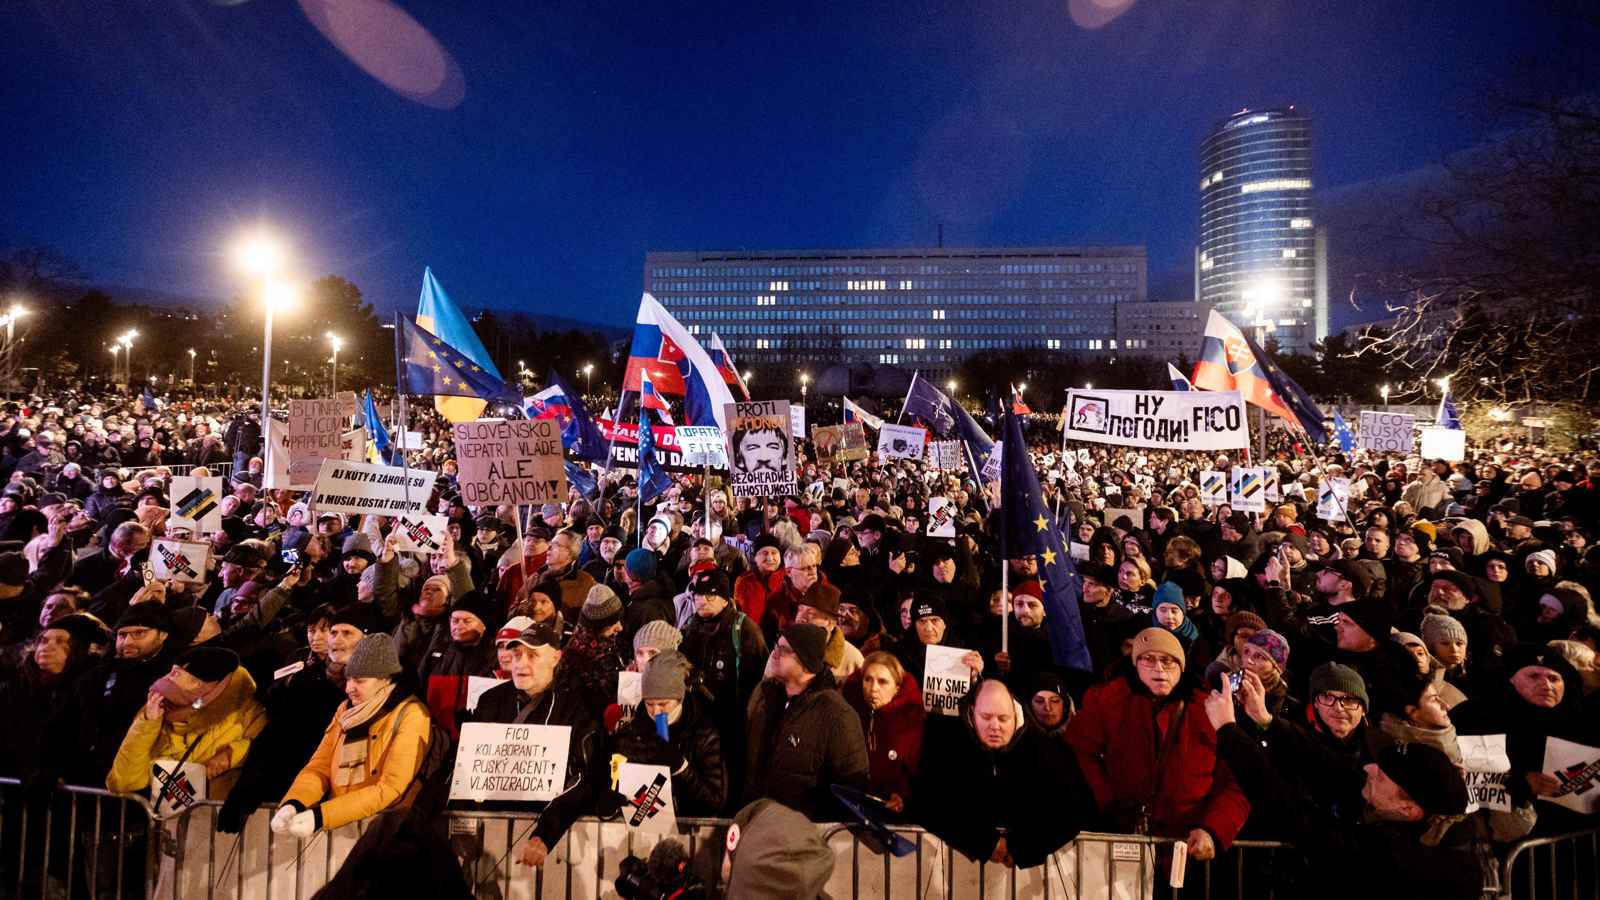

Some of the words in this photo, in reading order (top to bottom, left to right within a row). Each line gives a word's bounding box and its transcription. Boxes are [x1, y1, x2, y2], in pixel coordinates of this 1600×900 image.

[736, 401, 776, 417] PROTI
[1135, 395, 1164, 416] НУ
[1193, 404, 1241, 432] FICO
[457, 422, 551, 440] SLOVENSKO
[1109, 414, 1189, 443] ПОГОДИ!
[1360, 436, 1408, 452] TROL
[332, 468, 344, 479] AJ
[344, 469, 370, 482] KÚTY
[369, 473, 377, 482] A
[377, 472, 412, 487] ZÁHORE
[488, 460, 534, 480] ALE
[466, 480, 558, 504] OBČANOM!
[317, 494, 323, 504] A
[324, 494, 356, 507] MUSIA
[356, 497, 390, 509] ZOSTAŤ
[926, 675, 942, 690] MY
[945, 678, 967, 695] SME
[925, 692, 959, 710] EURÓP
[505, 727, 529, 741] FICO
[510, 760, 556, 775] AGENT!
